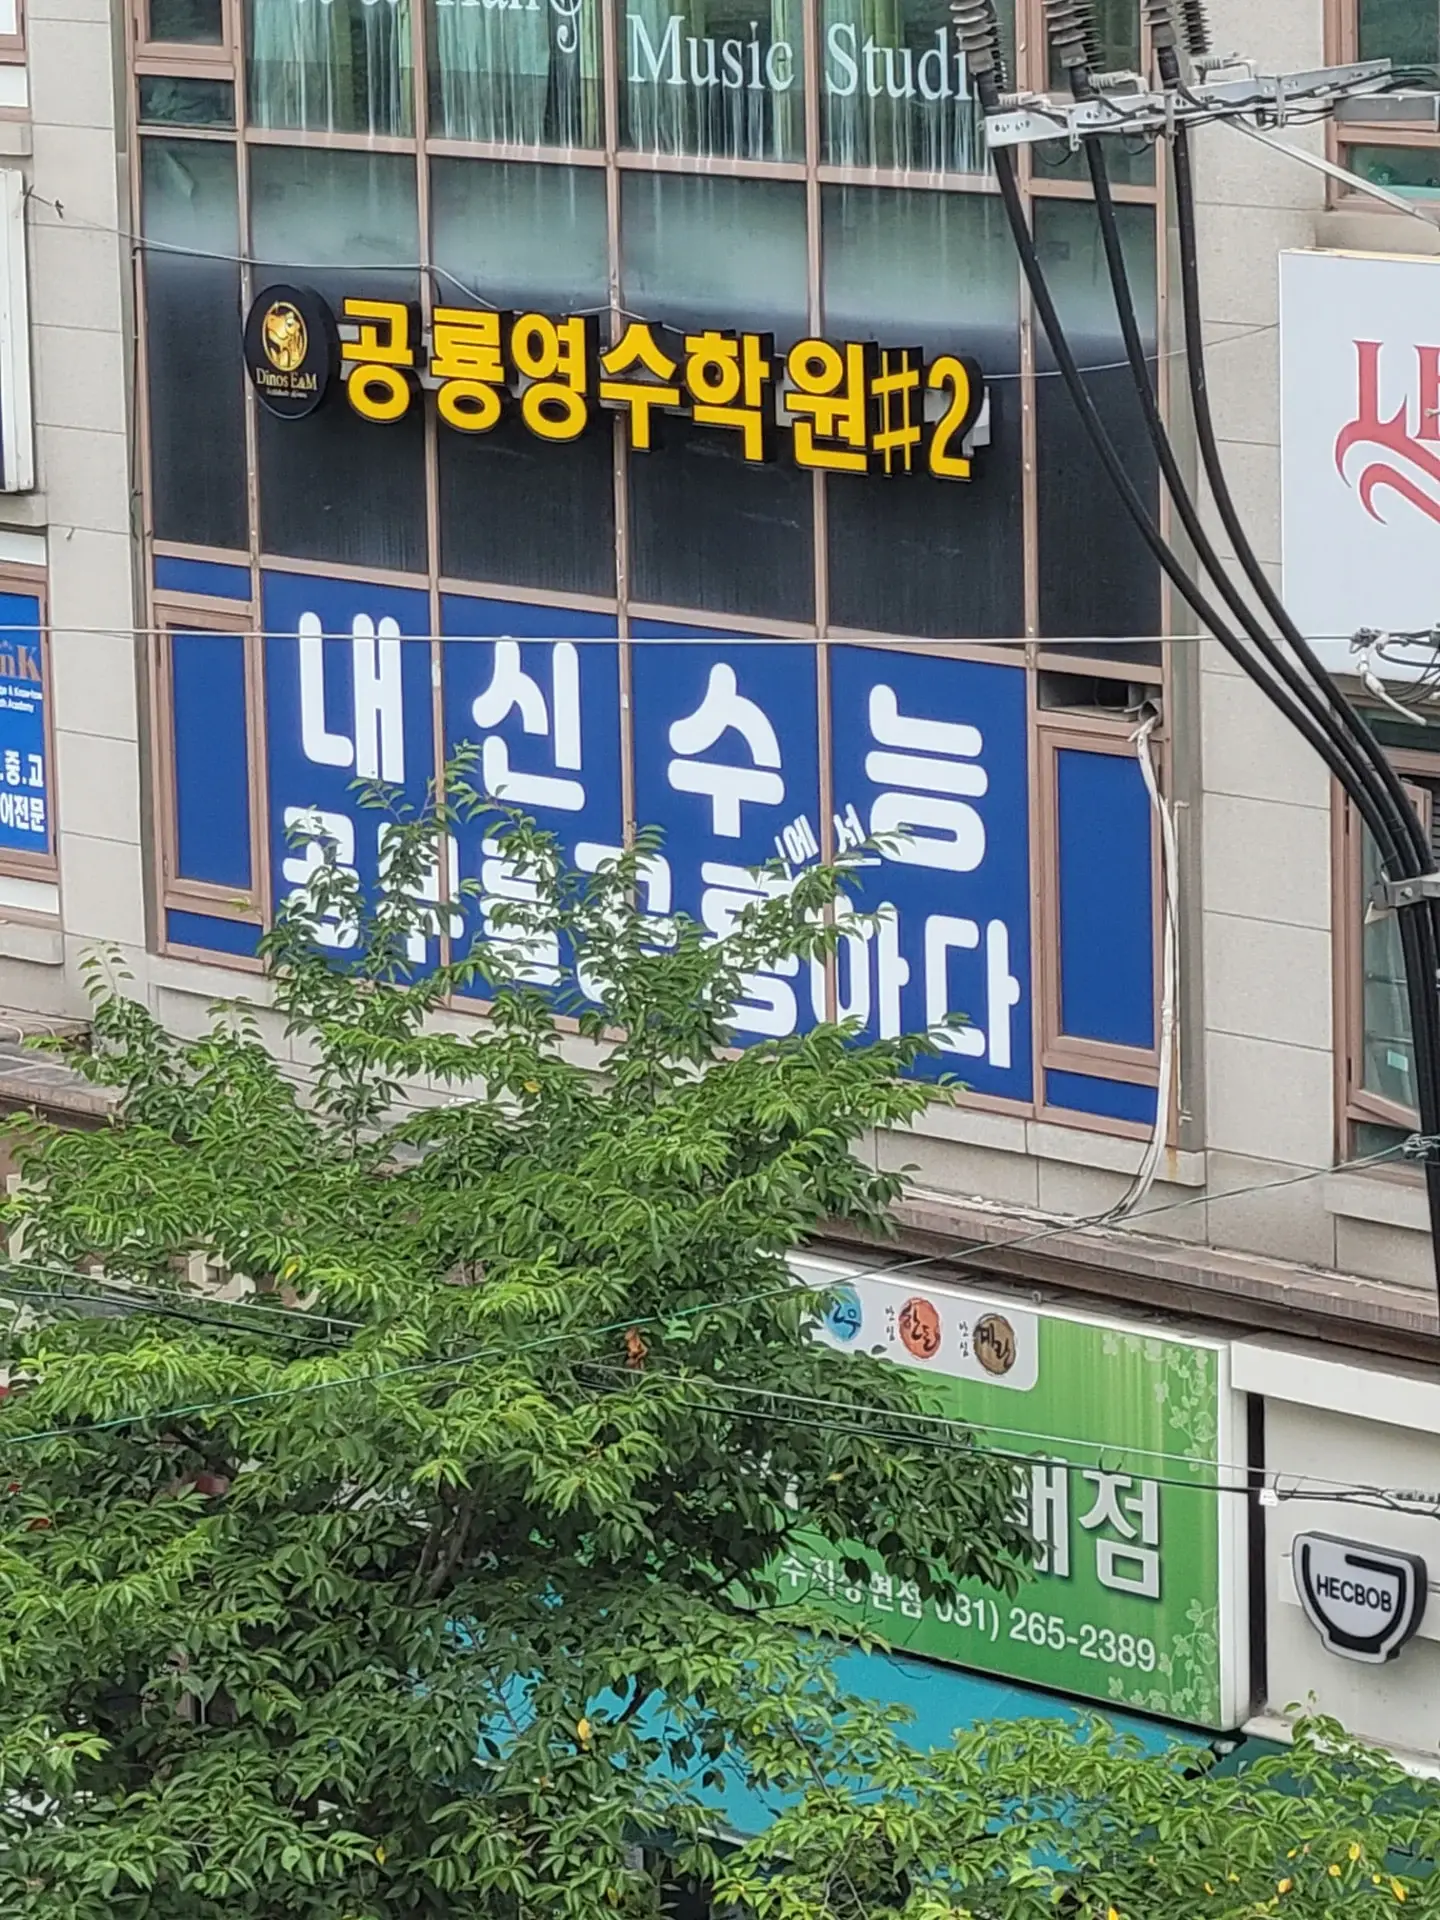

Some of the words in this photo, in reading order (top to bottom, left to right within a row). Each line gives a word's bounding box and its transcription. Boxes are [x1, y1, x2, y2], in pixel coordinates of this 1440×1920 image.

[626, 14, 796, 92] Music
[825, 22, 975, 101] Studi
[255, 366, 289, 388] Dinos
[340, 297, 975, 479] 공룡영수학원#2
[782, 803, 868, 865] 에서
[1316, 1573, 1394, 1613] HECBOB
[1008, 1607, 1157, 1673] 265-2389
